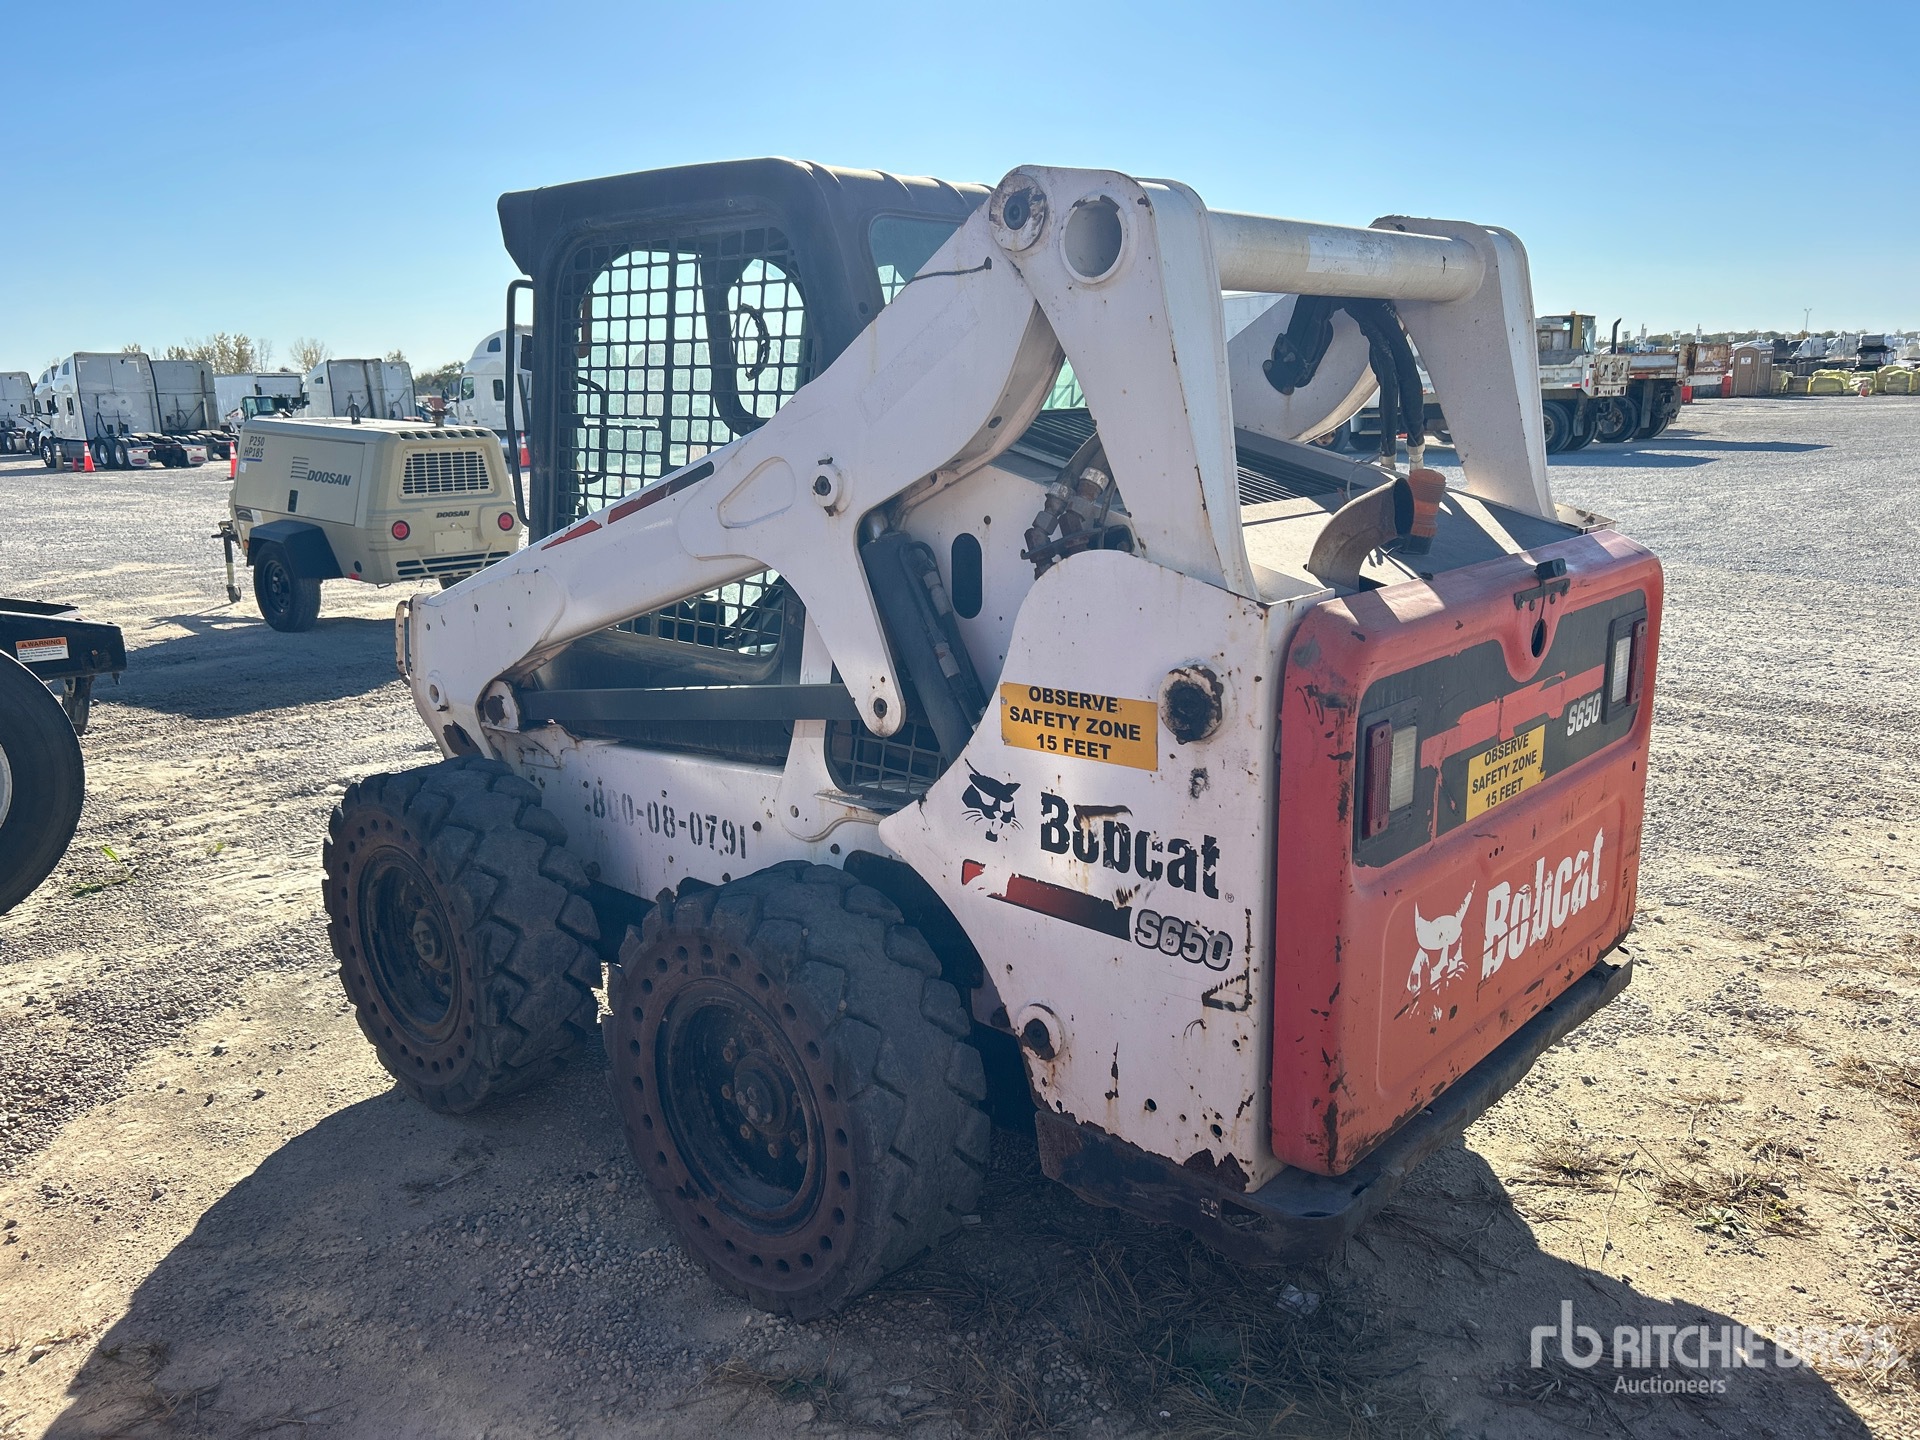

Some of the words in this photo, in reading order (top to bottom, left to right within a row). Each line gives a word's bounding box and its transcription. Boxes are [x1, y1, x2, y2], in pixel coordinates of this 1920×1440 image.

[244, 447, 264, 458] HP185
[249, 436, 265, 446] P250
[307, 470, 351, 486] DOOSAN
[436, 510, 470, 518] DOOSAN
[28, 639, 61, 647] WARNING
[1028, 685, 1119, 713] OBSERVE
[1566, 693, 1601, 736] S650
[1009, 705, 1080, 733] SAFETY
[1086, 718, 1141, 742] ZONE
[1036, 733, 1058, 753] 15
[1063, 737, 1111, 760] FEET
[1484, 734, 1530, 767] OBSERVE
[1471, 764, 1510, 794] SAFETY
[1511, 750, 1538, 777] ZONE
[1485, 790, 1497, 808] 15
[1499, 777, 1523, 802] FEET
[1041, 791, 1220, 899] Bobcat
[1481, 827, 1604, 981] Bobcat
[1135, 908, 1233, 972] S650
